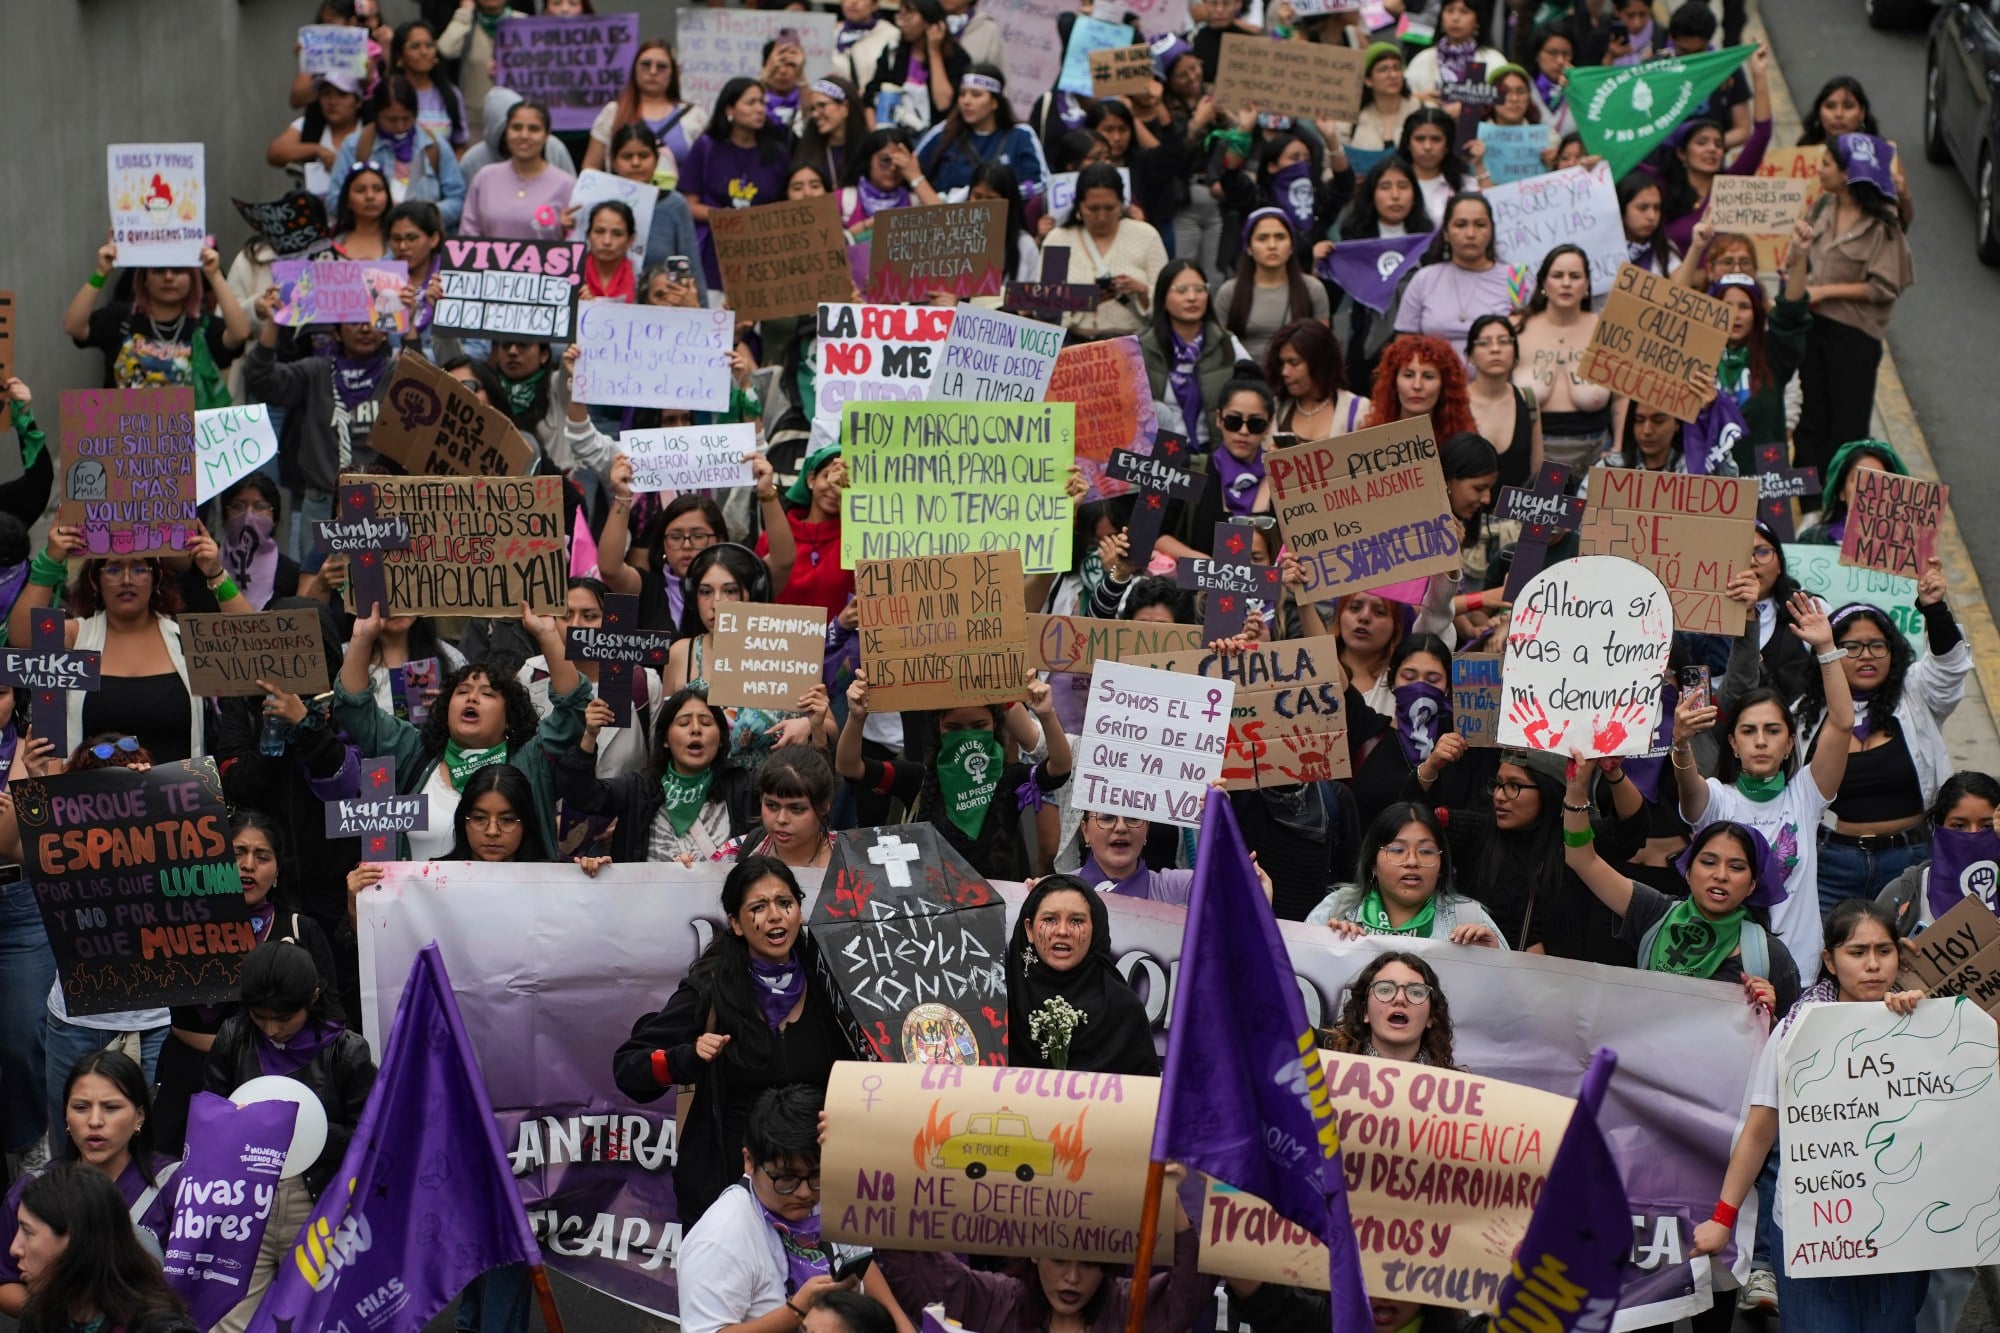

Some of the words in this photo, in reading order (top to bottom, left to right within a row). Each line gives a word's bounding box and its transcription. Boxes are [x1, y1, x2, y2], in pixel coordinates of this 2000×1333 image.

[500, 31, 522, 48] LA
[608, 26, 630, 43] ES
[603, 48, 617, 64] Y
[598, 68, 624, 84] DE
[1616, 129, 1635, 142] NO
[1713, 209, 1770, 225] SIEMPRE
[827, 250, 846, 269] EN
[963, 238, 988, 253] MUY
[445, 240, 585, 286] VIVAS!
[910, 257, 973, 279] MOLESTA
[1618, 267, 1639, 293] SI
[1639, 276, 1656, 302] EL
[1664, 286, 1730, 331] SISTEMA
[1638, 307, 1689, 347] CALLA
[824, 342, 872, 375] NO
[882, 346, 932, 378] ME
[947, 346, 999, 374] PORQUE
[1003, 357, 1045, 381] DESDE
[1050, 359, 1120, 391] ESPANTAS
[119, 414, 150, 434] POR
[157, 412, 193, 433] LAS
[447, 392, 485, 432] NOS
[78, 437, 117, 457] QUE
[122, 435, 196, 455] SALIERON
[630, 436, 654, 453] Por
[663, 434, 689, 451] las
[700, 434, 730, 450] que
[129, 457, 192, 478] NUNCA
[205, 437, 261, 489] MÍO
[630, 454, 689, 473] SALIERON
[696, 455, 704, 468] y
[631, 472, 662, 488] más
[669, 466, 740, 485] VOLVIERON
[1117, 452, 1192, 488] Evelyn
[1269, 449, 1334, 500] PNP
[1347, 435, 1436, 478] presente
[76, 474, 95, 486] NO
[1125, 471, 1171, 492] LAURA
[1856, 470, 1876, 496] LA
[487, 482, 535, 512] NOS
[850, 493, 903, 525] ELLA
[917, 495, 947, 525] NO
[951, 491, 1019, 524] TENGA
[1026, 494, 1068, 522] QUE
[1282, 502, 1318, 525] para
[1323, 488, 1362, 512] DINA
[1366, 466, 1425, 498] AUSENTE
[1508, 489, 1569, 517] Heydi
[85, 501, 197, 522] VOLVIERON
[443, 512, 453, 535] Y
[459, 512, 513, 536] ELLOS
[517, 513, 557, 537] SON
[1509, 509, 1560, 526] MACEDO
[1857, 494, 1937, 528] SECUESTRA
[320, 517, 409, 542] Kimberly
[1291, 530, 1328, 552] para
[1334, 519, 1362, 538] las
[1631, 514, 1673, 557] SE
[1859, 515, 1915, 546] VIOLA
[1299, 514, 1460, 593] DESAPARECIDAS
[1854, 538, 1918, 574] MATA
[861, 563, 893, 598] 14
[901, 557, 958, 593] AÑOS
[973, 554, 1001, 586] DE
[917, 596, 934, 621] NI
[940, 593, 959, 618] UN
[971, 587, 1002, 614] DÍA
[185, 619, 203, 638] TE
[211, 619, 271, 636] CANSAS
[277, 617, 299, 632] DE
[718, 613, 737, 633] EL
[747, 616, 828, 638] FEMINISMO
[864, 628, 884, 654] DE
[899, 621, 957, 648] JUSTICIA
[967, 617, 1002, 642] PARA
[243, 635, 314, 651] NOSOTRAS
[582, 646, 644, 662] CHOCANO
[744, 637, 788, 651] SALVA
[1047, 623, 1069, 666] 1
[1511, 638, 1561, 665] vas
[1572, 643, 1588, 665] a
[1603, 630, 1668, 666] tomar
[193, 656, 213, 669] DE
[216, 655, 307, 681] VIVIRLO
[714, 658, 733, 672] EL
[740, 658, 819, 675] MACHISMO
[866, 661, 896, 687] LAS
[902, 653, 953, 683] NIÑAS
[19, 674, 80, 688] VALDEZ
[743, 680, 788, 695] MATA
[1511, 683, 1536, 705] mi
[1549, 673, 1664, 711] denuncia?
[1161, 728, 1187, 747] DE
[1195, 733, 1225, 755] LAS
[954, 752, 961, 764] NI
[1093, 744, 1128, 768] QUE
[1141, 753, 1163, 775] YA
[1180, 762, 1205, 781] NO
[52, 781, 147, 827] PORQUÉ
[160, 781, 200, 815] TE
[340, 796, 420, 819] Karim
[956, 796, 987, 811] ABORTO
[340, 816, 414, 832] ALVARADO
[38, 815, 226, 875] ESPANTAS
[36, 881, 71, 904] POR
[78, 879, 112, 900] LAS
[118, 875, 154, 895] QUE
[159, 862, 244, 897] LUCHAN
[54, 910, 69, 932] Y
[75, 907, 107, 930] NO
[114, 903, 158, 926] POR
[165, 901, 212, 923] LAS
[869, 897, 951, 941] RIP
[75, 931, 135, 959] QUE
[140, 921, 256, 960] MUEREN
[1921, 922, 1979, 976] HOY
[1847, 1052, 1895, 1080] LAS
[1887, 1071, 1955, 1100] NIÑAS
[1787, 1097, 1880, 1124] DEBERÍAN
[976, 1143, 1010, 1157] POLICE
[1791, 1140, 1859, 1163] LLEVAR
[856, 1168, 896, 1202] NO
[913, 1176, 957, 1208] ME
[1794, 1169, 1867, 1195] SUEÑOS
[1813, 1198, 1853, 1227] NO
[1429, 1222, 1451, 1258] y
[1791, 1235, 1879, 1266] ATAÚDES
[355, 1276, 405, 1319] HIAS
